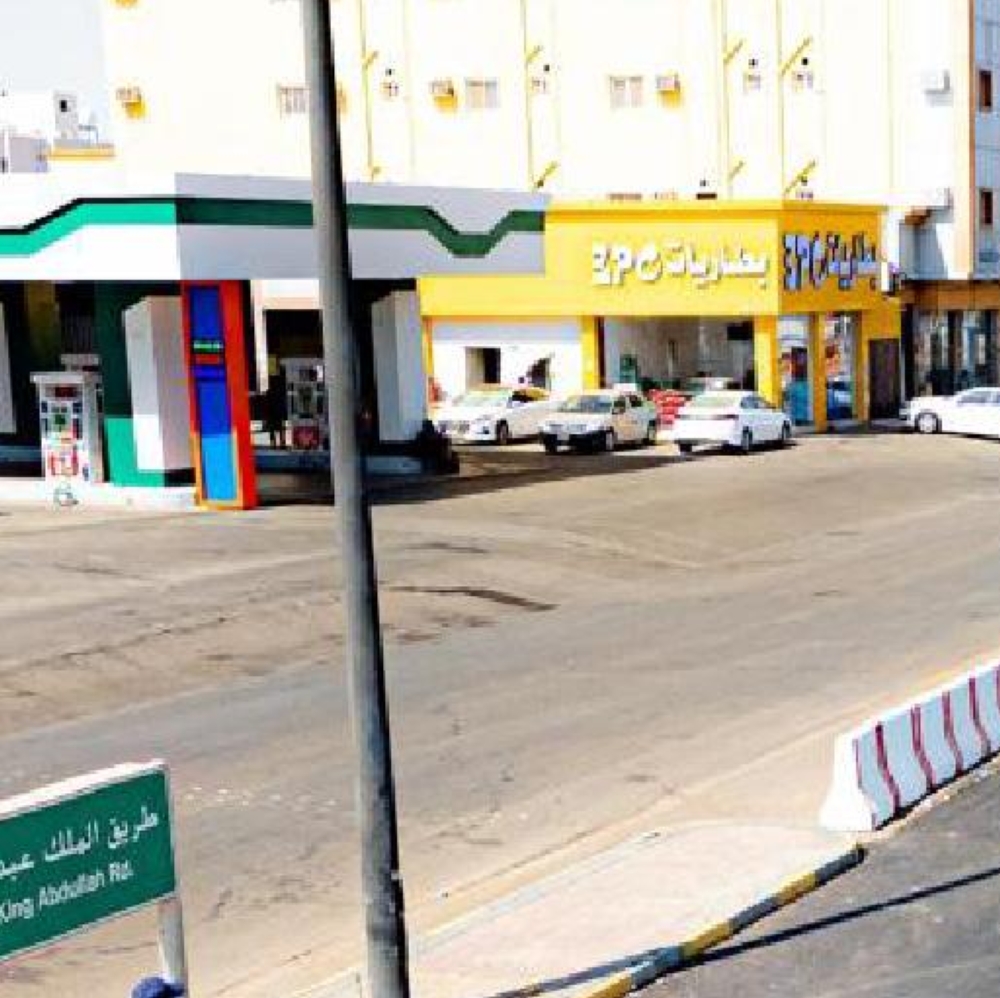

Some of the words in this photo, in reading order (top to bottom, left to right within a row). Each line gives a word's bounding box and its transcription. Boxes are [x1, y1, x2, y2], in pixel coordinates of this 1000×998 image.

[45, 819, 99, 862] الملك
[107, 805, 158, 850] طريق
[39, 870, 105, 911] Abdullah
